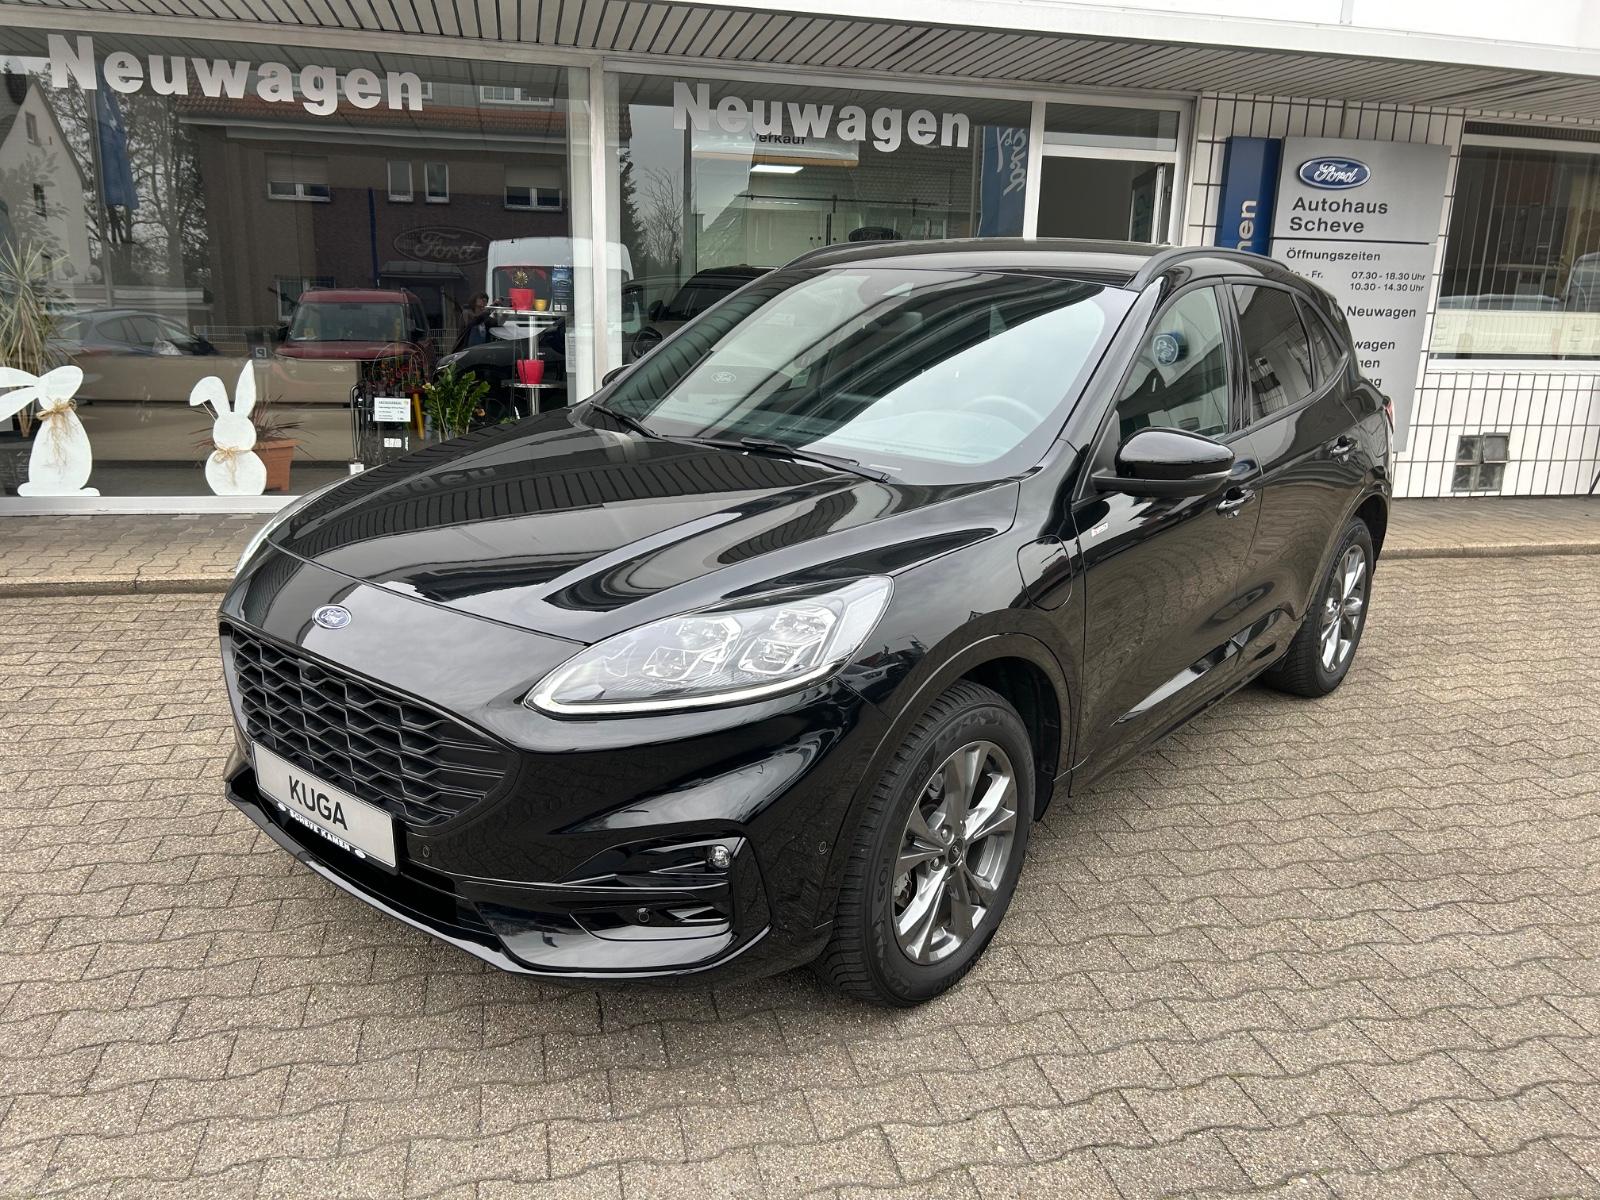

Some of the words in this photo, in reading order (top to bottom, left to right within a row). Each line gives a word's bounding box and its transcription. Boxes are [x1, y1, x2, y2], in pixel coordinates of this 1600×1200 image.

[47, 33, 423, 116] Neuwagen
[673, 81, 970, 153] Neuwagen
[1313, 161, 1360, 184] Ford
[1292, 196, 1388, 215] Autohaus
[1289, 216, 1365, 233] Scheve
[1286, 247, 1381, 262] Öffnungszeiten
[1311, 270, 1324, 279] Fr.
[1351, 271, 1378, 280] 07.30
[1385, 272, 1410, 281] 18.30
[1411, 272, 1426, 281] Uhr
[1350, 282, 1376, 291] 10.30
[1384, 283, 1408, 292] 14.30
[1409, 283, 1424, 292] Uhr
[1346, 305, 1417, 320] Neuwagen
[288, 775, 349, 831] KUGA
